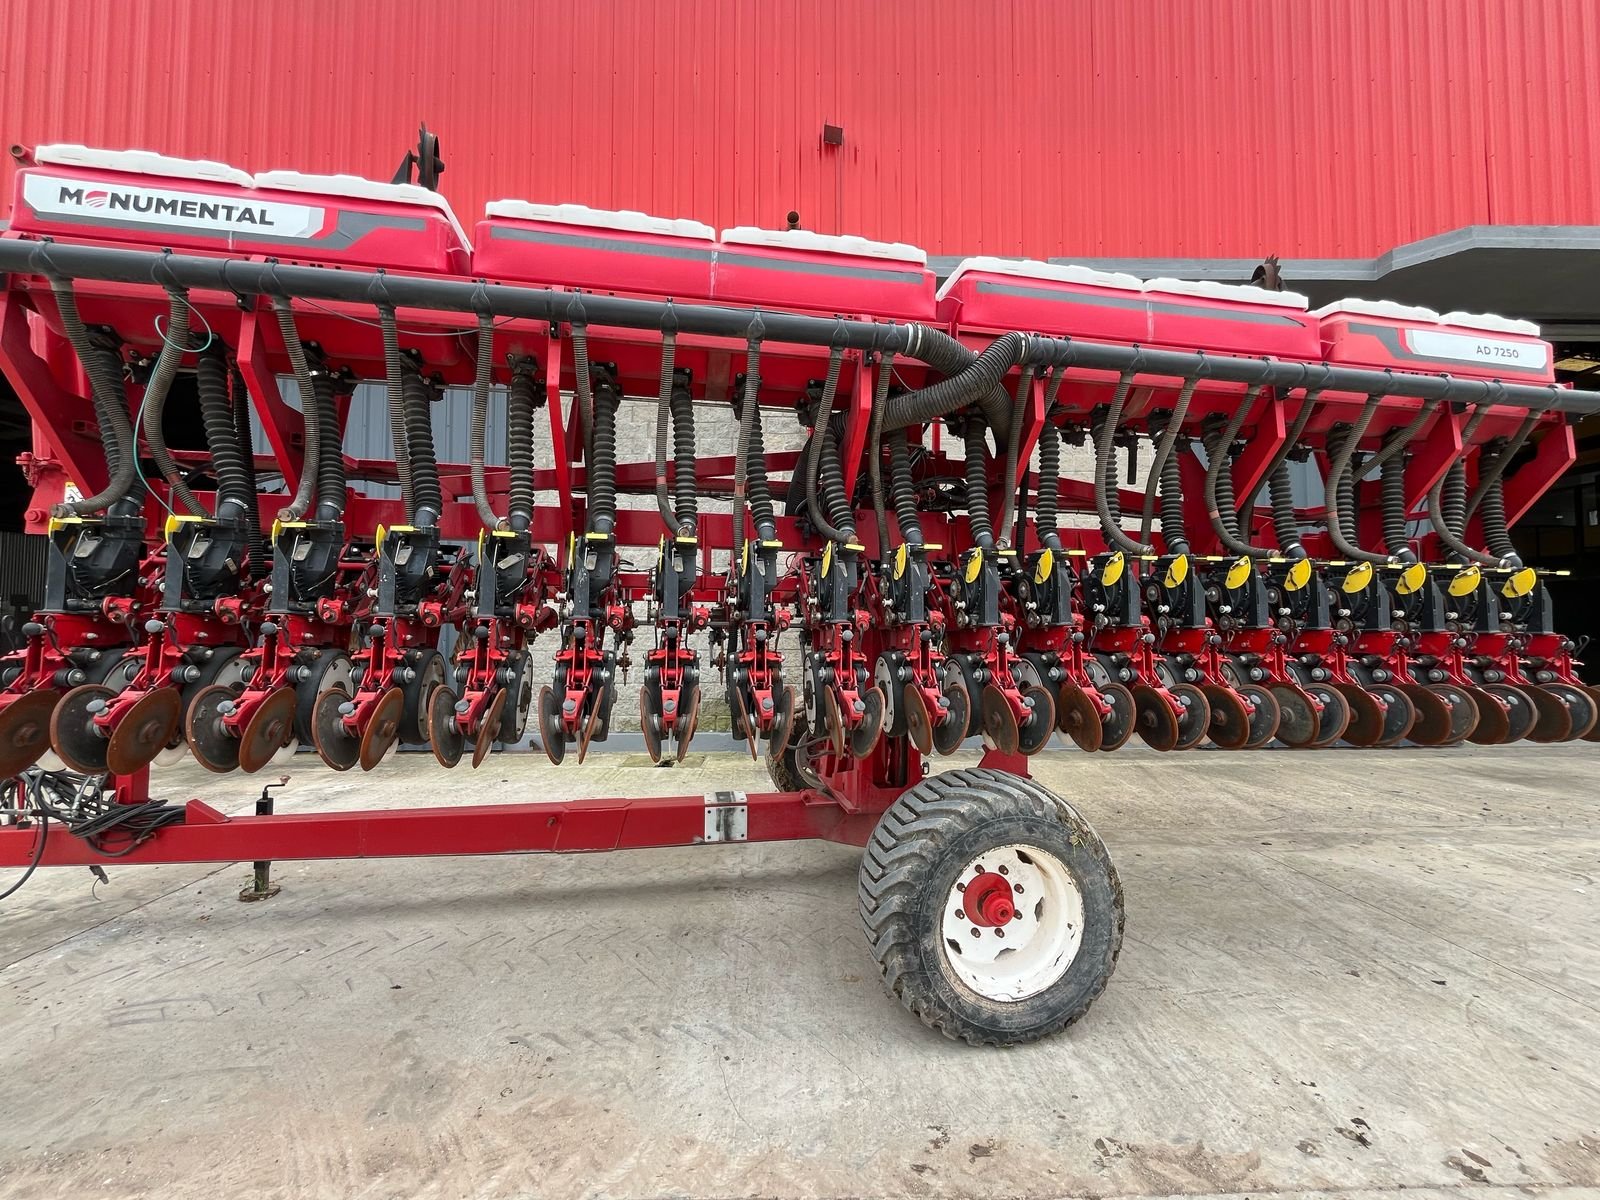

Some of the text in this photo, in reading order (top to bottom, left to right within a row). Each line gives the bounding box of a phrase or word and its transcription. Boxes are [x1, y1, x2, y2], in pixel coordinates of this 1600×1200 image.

[59, 186, 275, 226] MONUMENTAL
[1476, 345, 1519, 358] AD 7250
